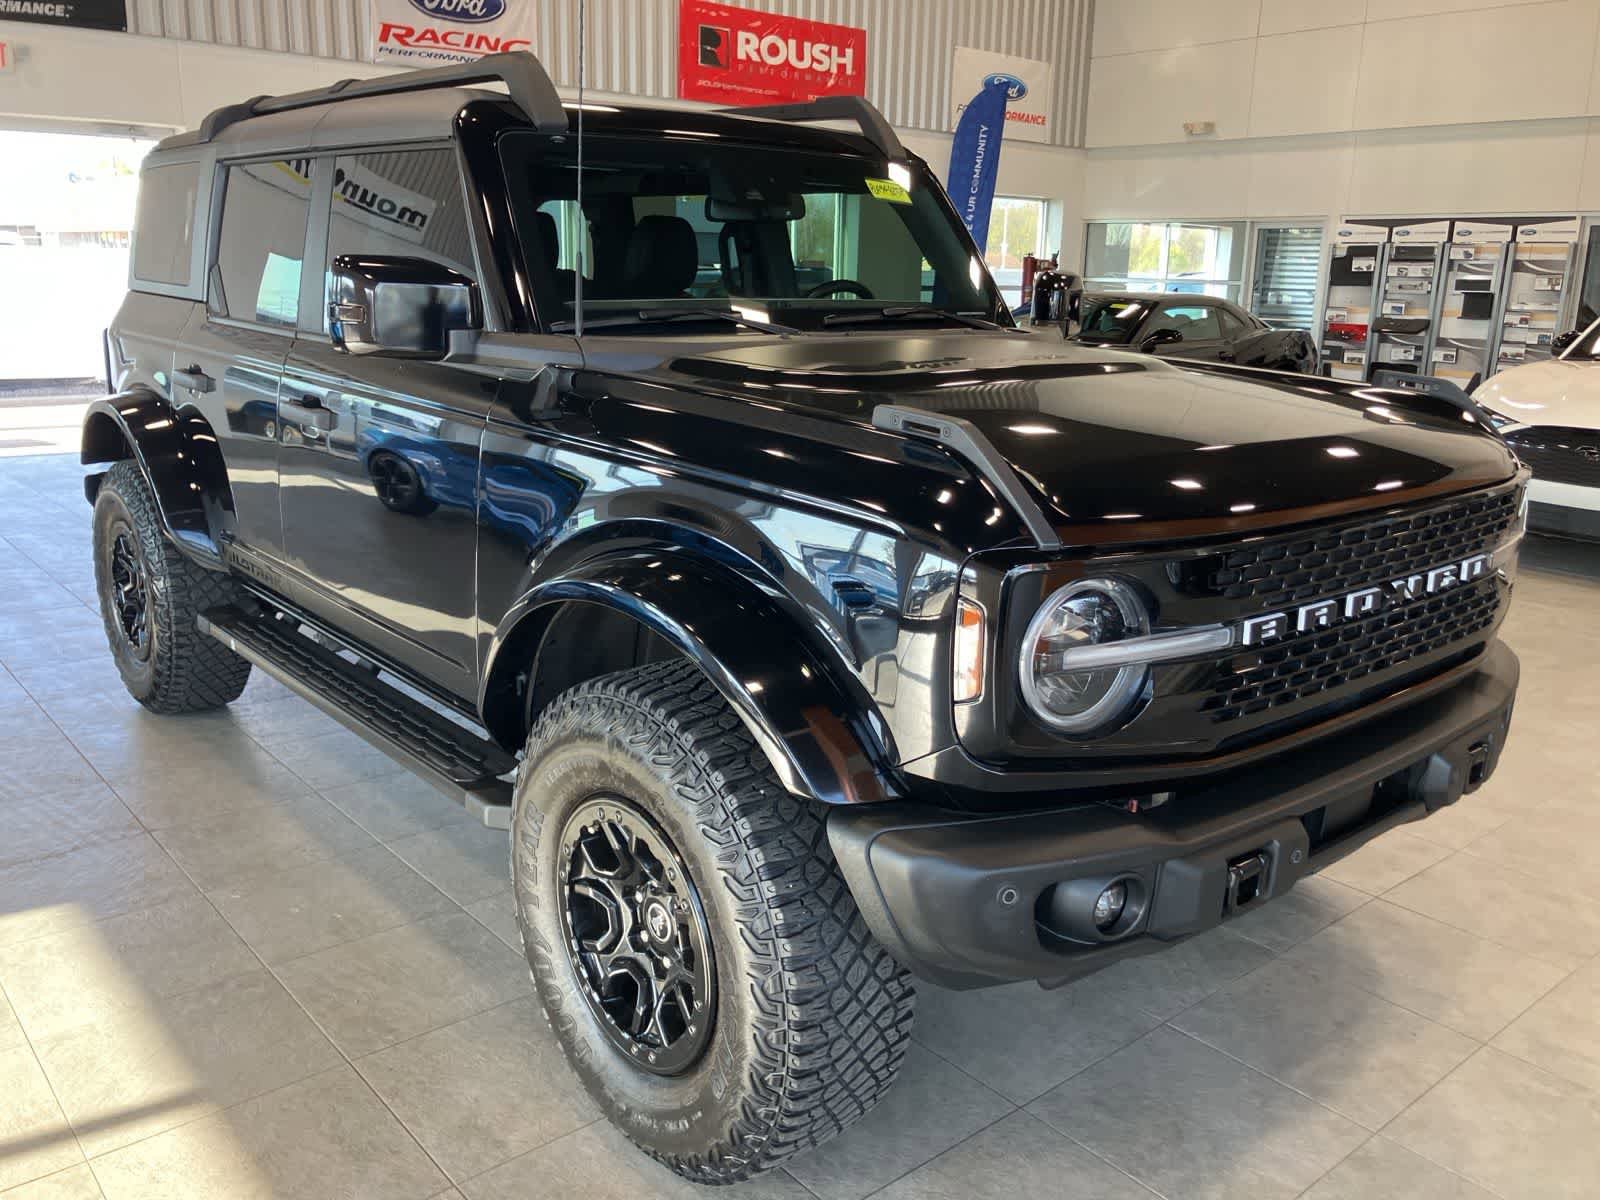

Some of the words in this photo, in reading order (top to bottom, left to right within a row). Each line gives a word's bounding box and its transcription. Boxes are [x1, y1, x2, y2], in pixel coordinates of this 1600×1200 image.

[379, 46, 479, 64] PERFORMANC
[736, 30, 854, 76] ROUSH
[1003, 110, 1047, 126] ORMANCE
[970, 124, 990, 194] COMMUNITY
[967, 196, 977, 213] UR
[1242, 553, 1488, 646] BRONCO
